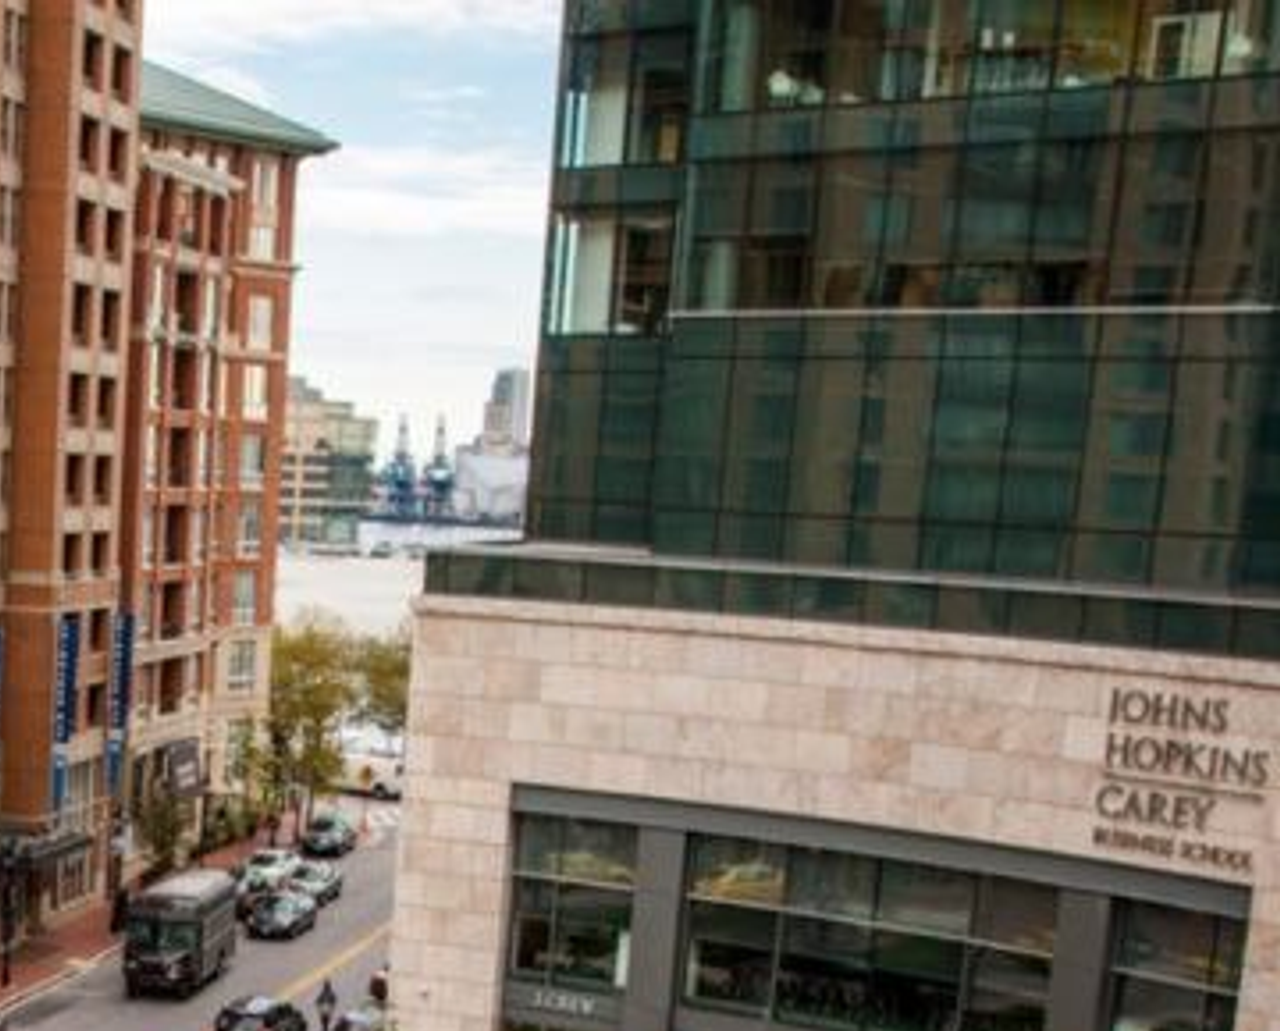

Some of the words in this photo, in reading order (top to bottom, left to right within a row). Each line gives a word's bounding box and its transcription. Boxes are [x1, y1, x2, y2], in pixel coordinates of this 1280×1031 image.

[1109, 687, 1229, 734] JOHNS
[1105, 732, 1270, 787] HOPKINS
[1095, 784, 1218, 834] CAREY
